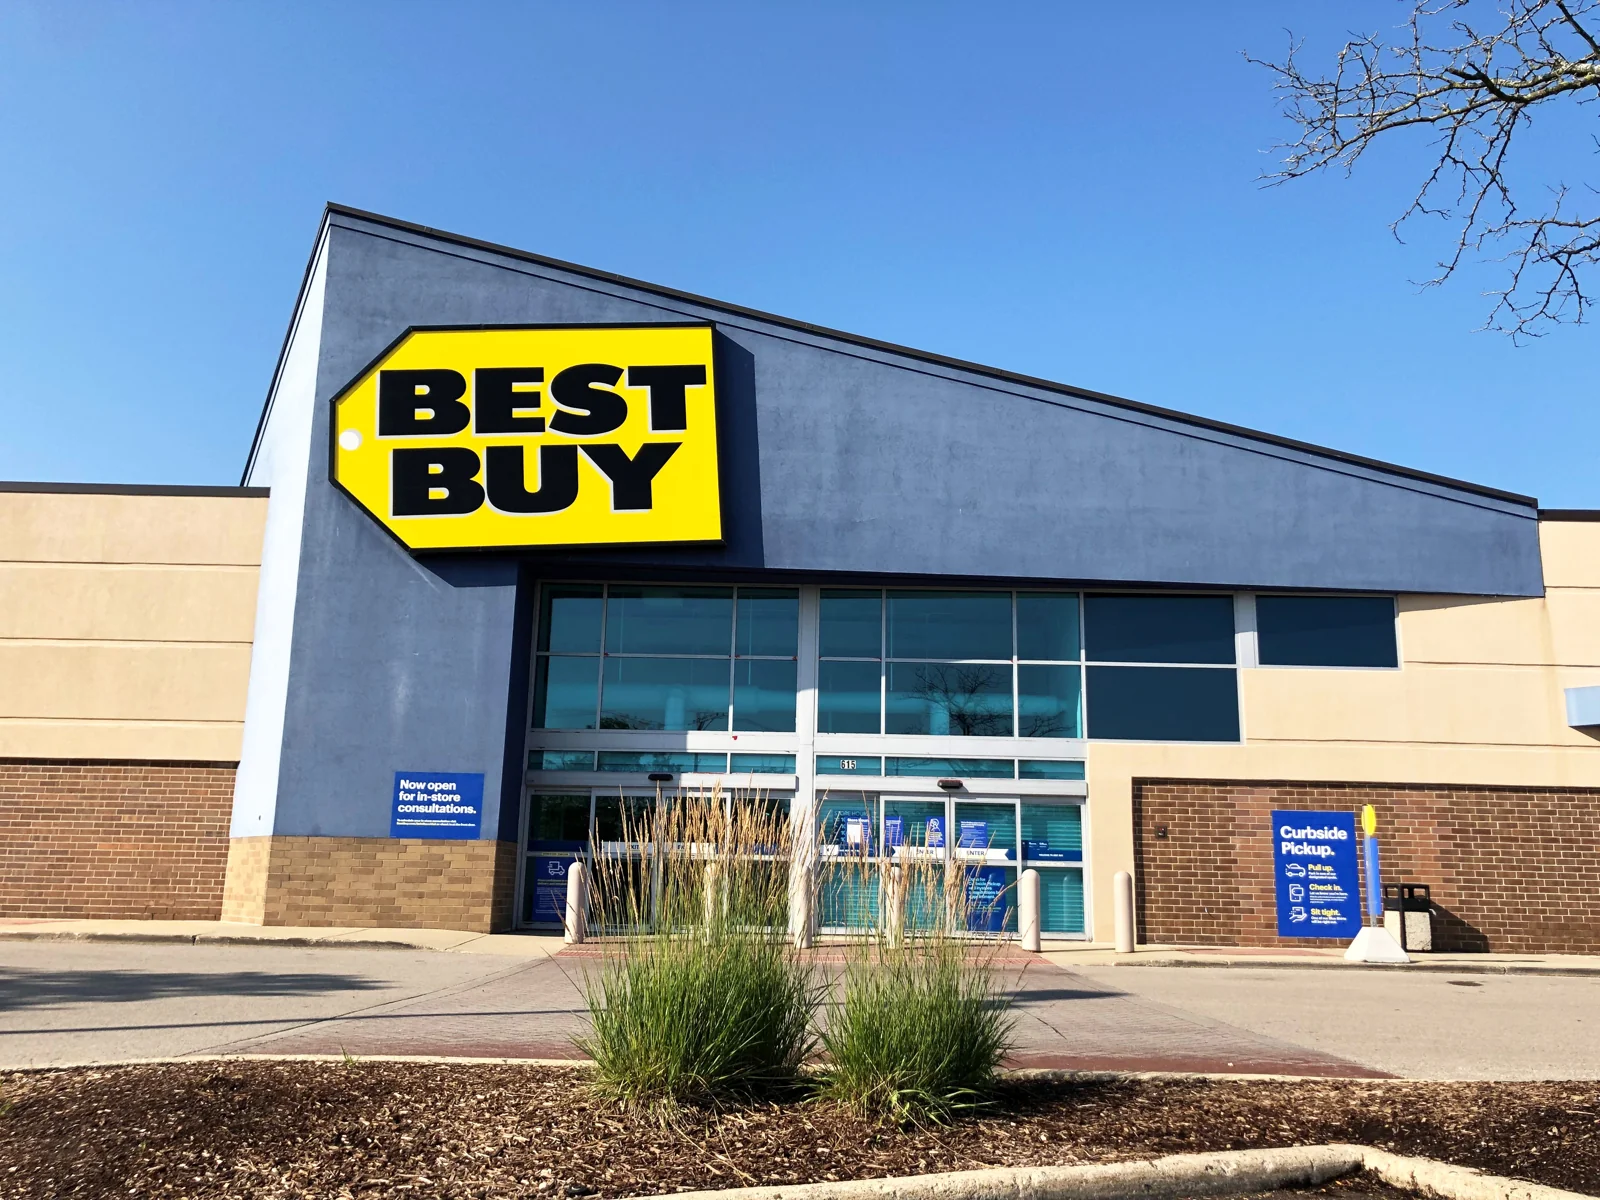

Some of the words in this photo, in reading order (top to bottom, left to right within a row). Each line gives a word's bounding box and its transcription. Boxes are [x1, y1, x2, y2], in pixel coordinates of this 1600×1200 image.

[378, 363, 706, 437] BEST
[391, 441, 683, 516] BUY
[842, 760, 856, 769] 615
[400, 779, 426, 790] Now
[427, 782, 456, 792] open
[399, 790, 416, 800] for
[416, 792, 461, 802] in-store
[398, 803, 476, 814] consultations.
[1280, 826, 1348, 840] Curbside
[1281, 842, 1336, 858] Pickup.
[1321, 909, 1341, 917] tight.
